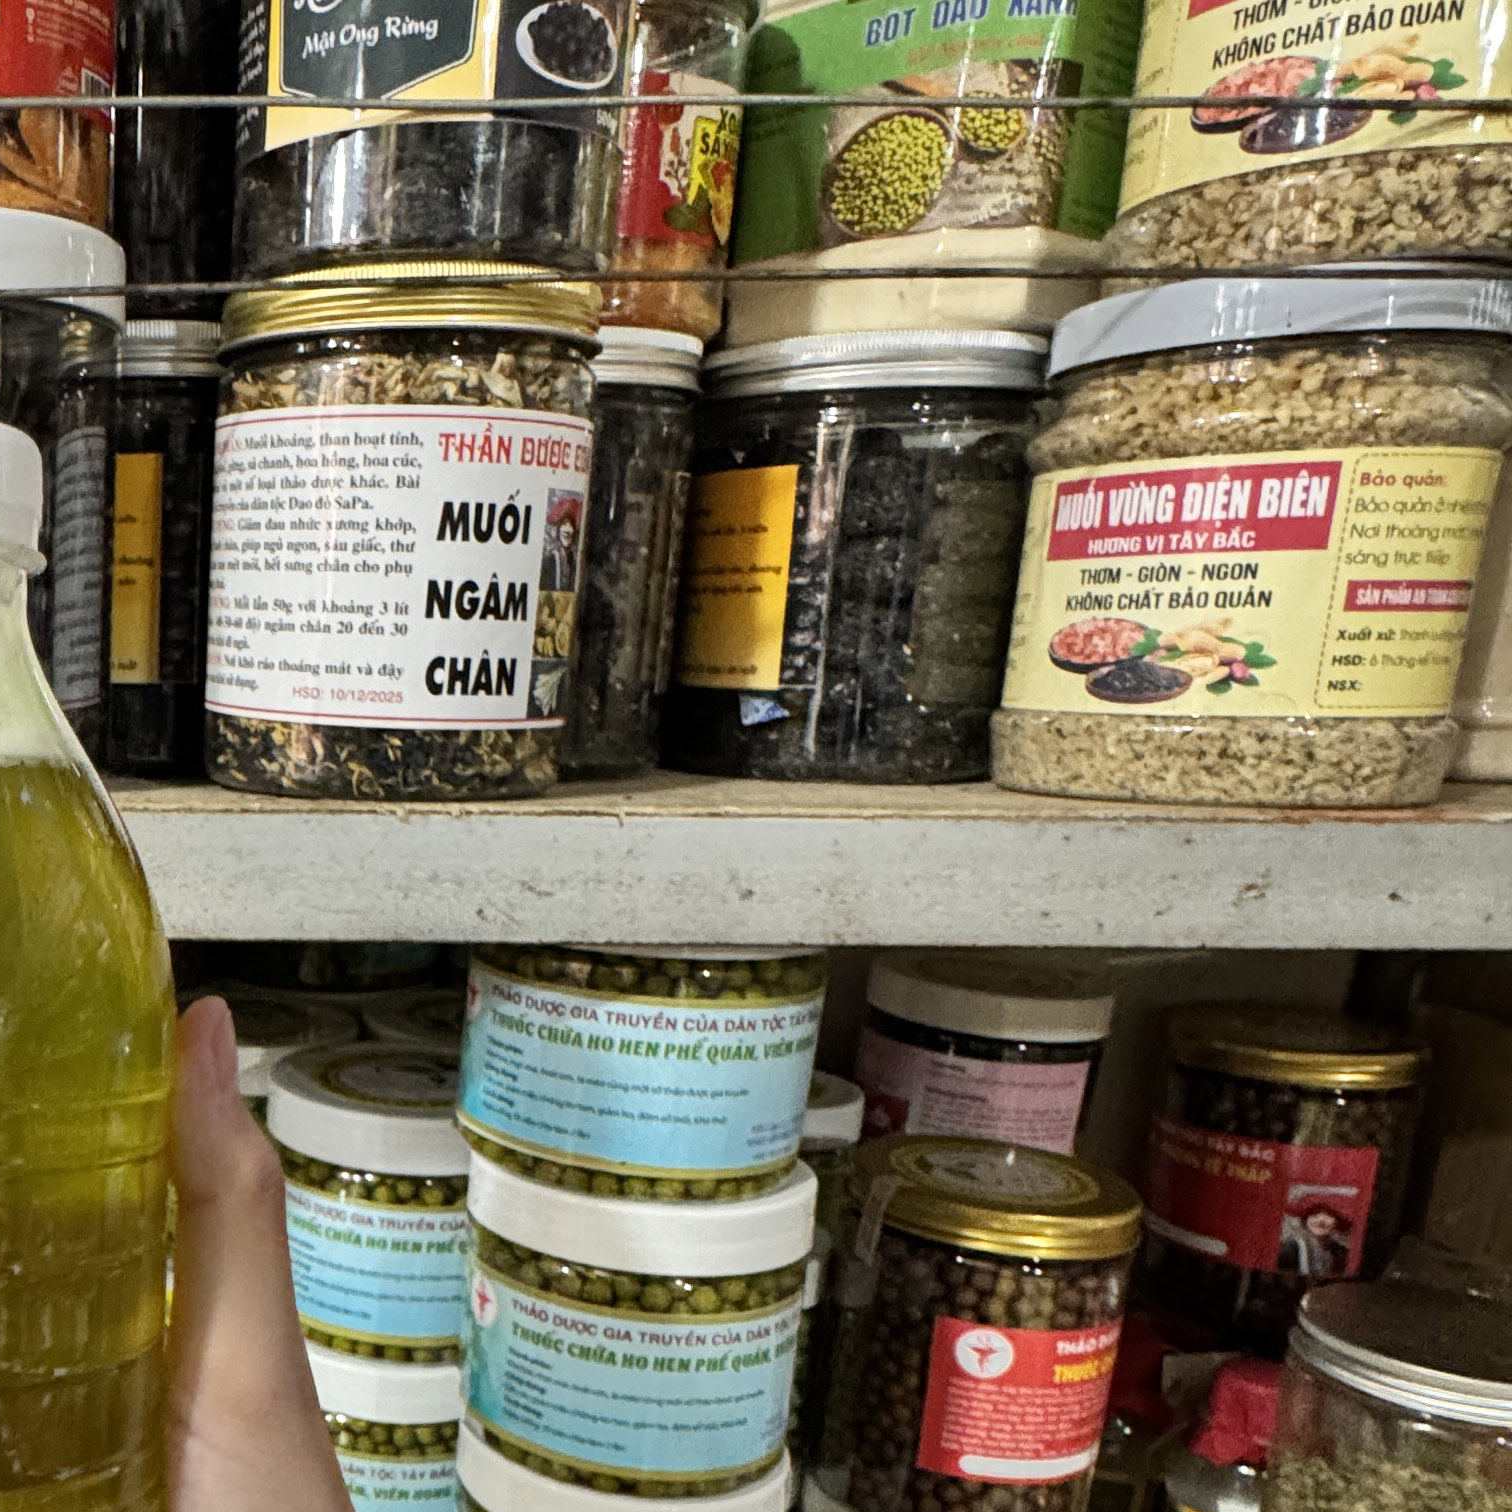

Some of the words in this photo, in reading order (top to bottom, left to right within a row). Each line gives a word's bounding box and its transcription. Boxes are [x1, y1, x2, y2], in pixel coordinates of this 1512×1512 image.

[302, 28, 337, 59] Mật
[339, 24, 379, 47] Ong
[384, 16, 438, 41] Rừng
[1212, 30, 1277, 70] KHÔNG
[1281, 12, 1341, 51] CHẤT
[1344, 1, 1394, 37] BẢO
[319, 433, 350, 446] than
[354, 432, 385, 449] hoạt
[389, 431, 424, 447] tính,
[439, 422, 512, 464] THẦN
[296, 455, 318, 468] hoa
[363, 453, 389, 467] hoa
[392, 453, 422, 469] cúc,
[280, 475, 307, 489] thảo
[349, 475, 390, 489] khác.
[395, 475, 421, 489] Bài
[1360, 469, 1396, 487] Bảo
[288, 497, 312, 510] Dao
[1055, 475, 1102, 532] MUỐI
[1108, 474, 1176, 529] VỪNG
[1180, 474, 1251, 534] ĐIỆN
[1257, 469, 1331, 518] BIÊN
[1354, 497, 1389, 514] Bảo
[1392, 497, 1433, 519] quản
[265, 518, 285, 531] đau
[290, 518, 321, 531] nhức
[375, 517, 417, 534] khớp,
[436, 489, 531, 545] MUỐI
[1088, 535, 1142, 557] HƯƠNG
[1145, 535, 1164, 556] VỊ
[1168, 528, 1206, 553] TÂY
[1213, 525, 1256, 550] BẮC
[1349, 523, 1381, 538] Nơi
[1385, 522, 1443, 542] thoáng
[390, 539, 416, 552] thư
[1344, 551, 1388, 567] sáng
[354, 561, 380, 574] cho
[384, 562, 413, 578] phụ
[1079, 567, 1121, 586] THƠM
[1138, 561, 1182, 583] GIÒN
[1201, 563, 1259, 581] NGON
[298, 597, 316, 613] với
[379, 602, 388, 615] 3
[394, 601, 409, 616] lít
[424, 572, 528, 622] NGÂM
[1065, 589, 1113, 612] KHÔNG
[1117, 584, 1162, 610] CHẤT
[1168, 582, 1210, 609] BẢO
[1214, 583, 1272, 609] QUẢN
[299, 619, 331, 634] chân
[336, 621, 354, 634] 20
[358, 619, 384, 636] đến
[390, 622, 408, 637] 30
[1336, 627, 1372, 641] Xuất
[1331, 654, 1368, 667] HSD:
[357, 662, 373, 676] và
[377, 663, 404, 680] đậy
[425, 649, 516, 698] CHÂN
[1327, 679, 1362, 692] NSX:
[329, 688, 403, 704] 10/12/2025
[570, 1005, 599, 1023] GIA
[606, 1010, 677, 1031] TRUYỀN
[682, 1013, 720, 1033] CỦA
[724, 1013, 756, 1033] DÂN
[537, 1021, 583, 1048] CHỮA
[587, 1033, 615, 1052] HO
[618, 1037, 660, 1058] HEN
[553, 1315, 599, 1338] DƯỢC
[603, 1325, 634, 1342] GIA
[639, 1327, 707, 1347] TRUYỀN
[711, 1324, 743, 1346] CỦA
[622, 1352, 648, 1371] HO
[652, 1356, 690, 1373] HEN
